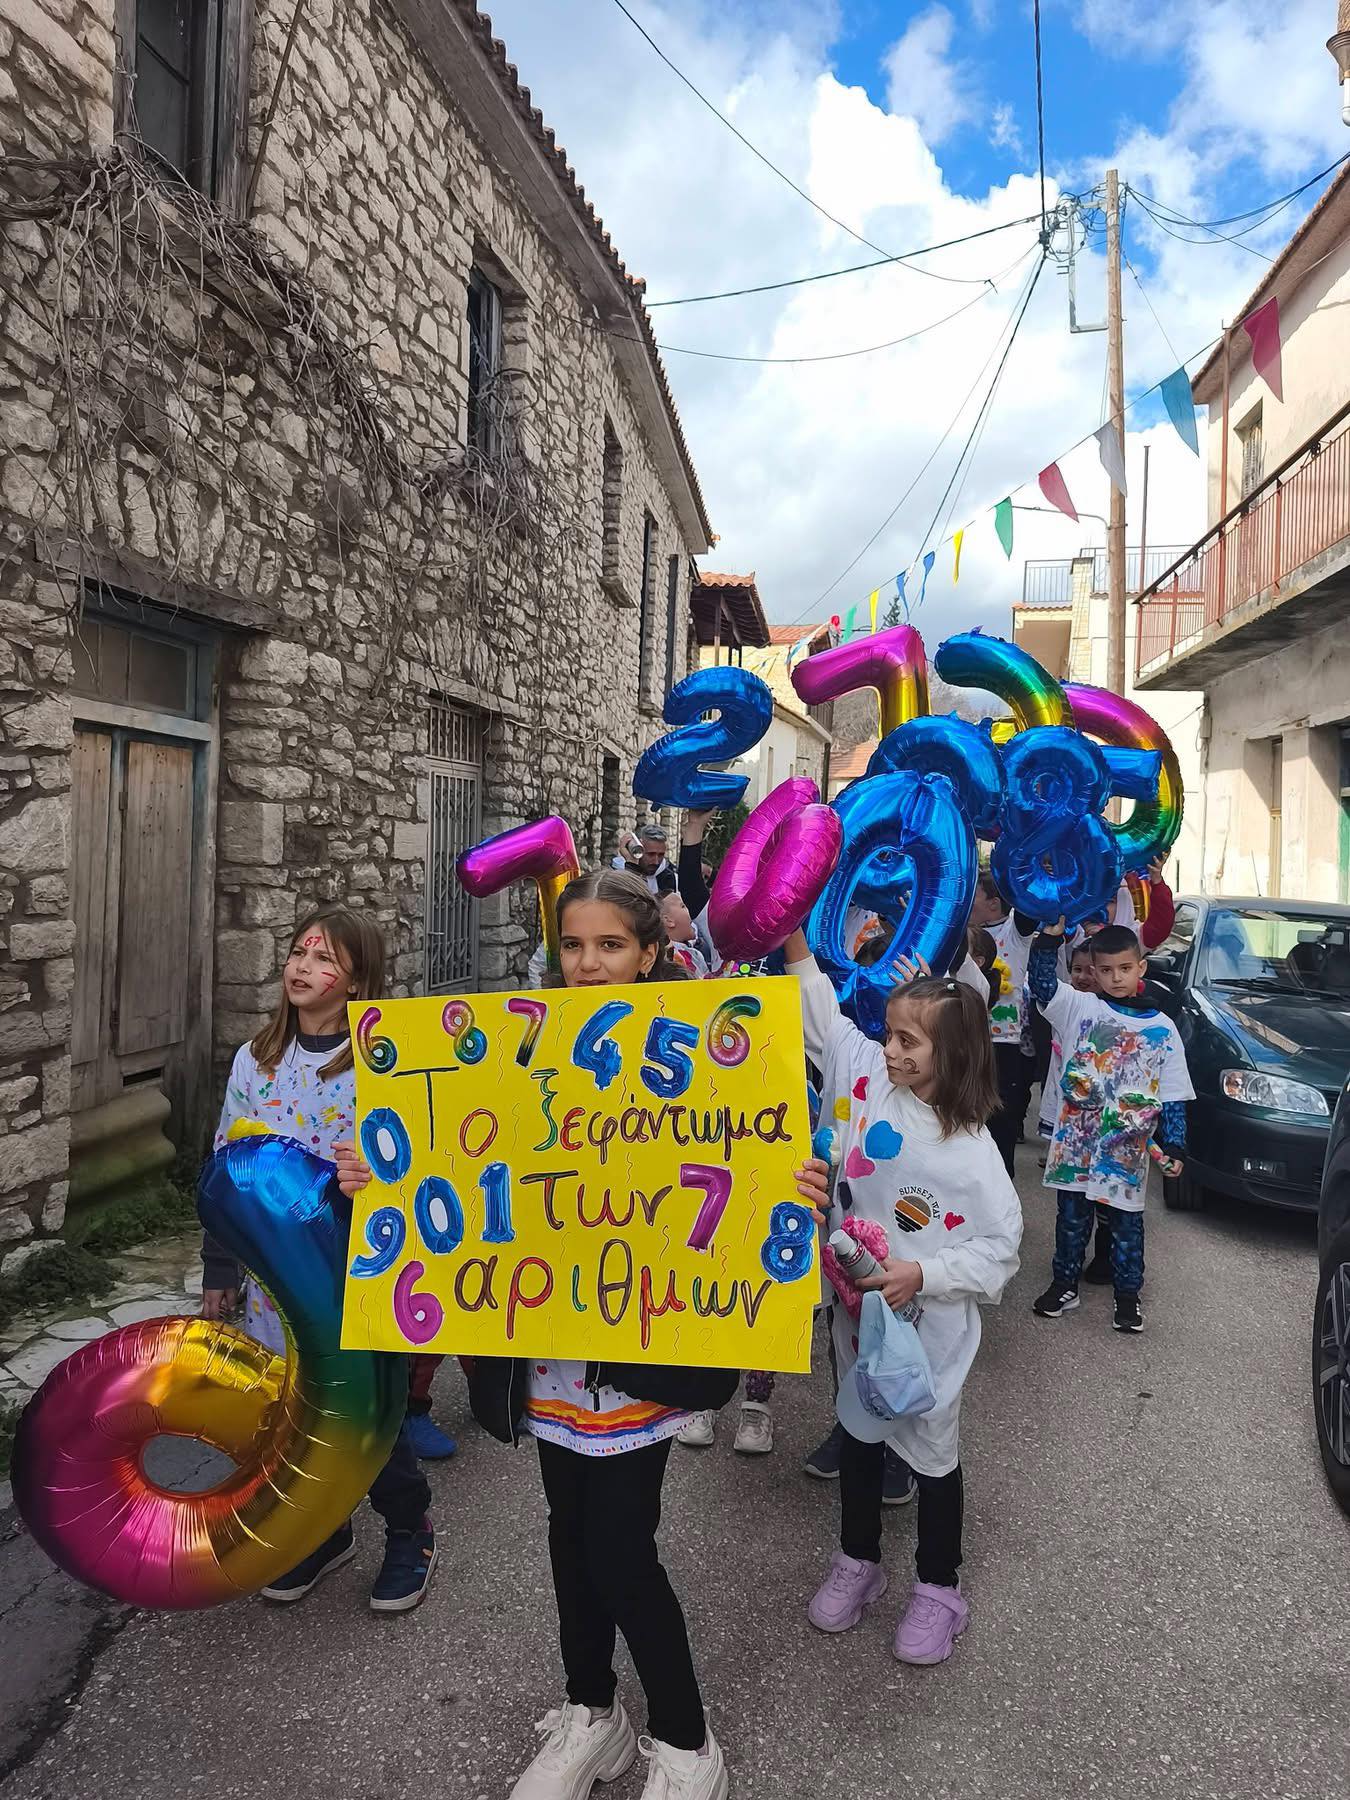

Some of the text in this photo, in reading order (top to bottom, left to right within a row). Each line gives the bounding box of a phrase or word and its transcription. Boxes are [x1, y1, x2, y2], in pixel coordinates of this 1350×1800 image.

[634, 665, 774, 812] 2
[356, 995, 762, 1099] 6 8 7 4 5 6
[391, 1067, 498, 1158] Το
[520, 1171, 672, 1230] των
[899, 1186, 934, 1200] SUNSET
